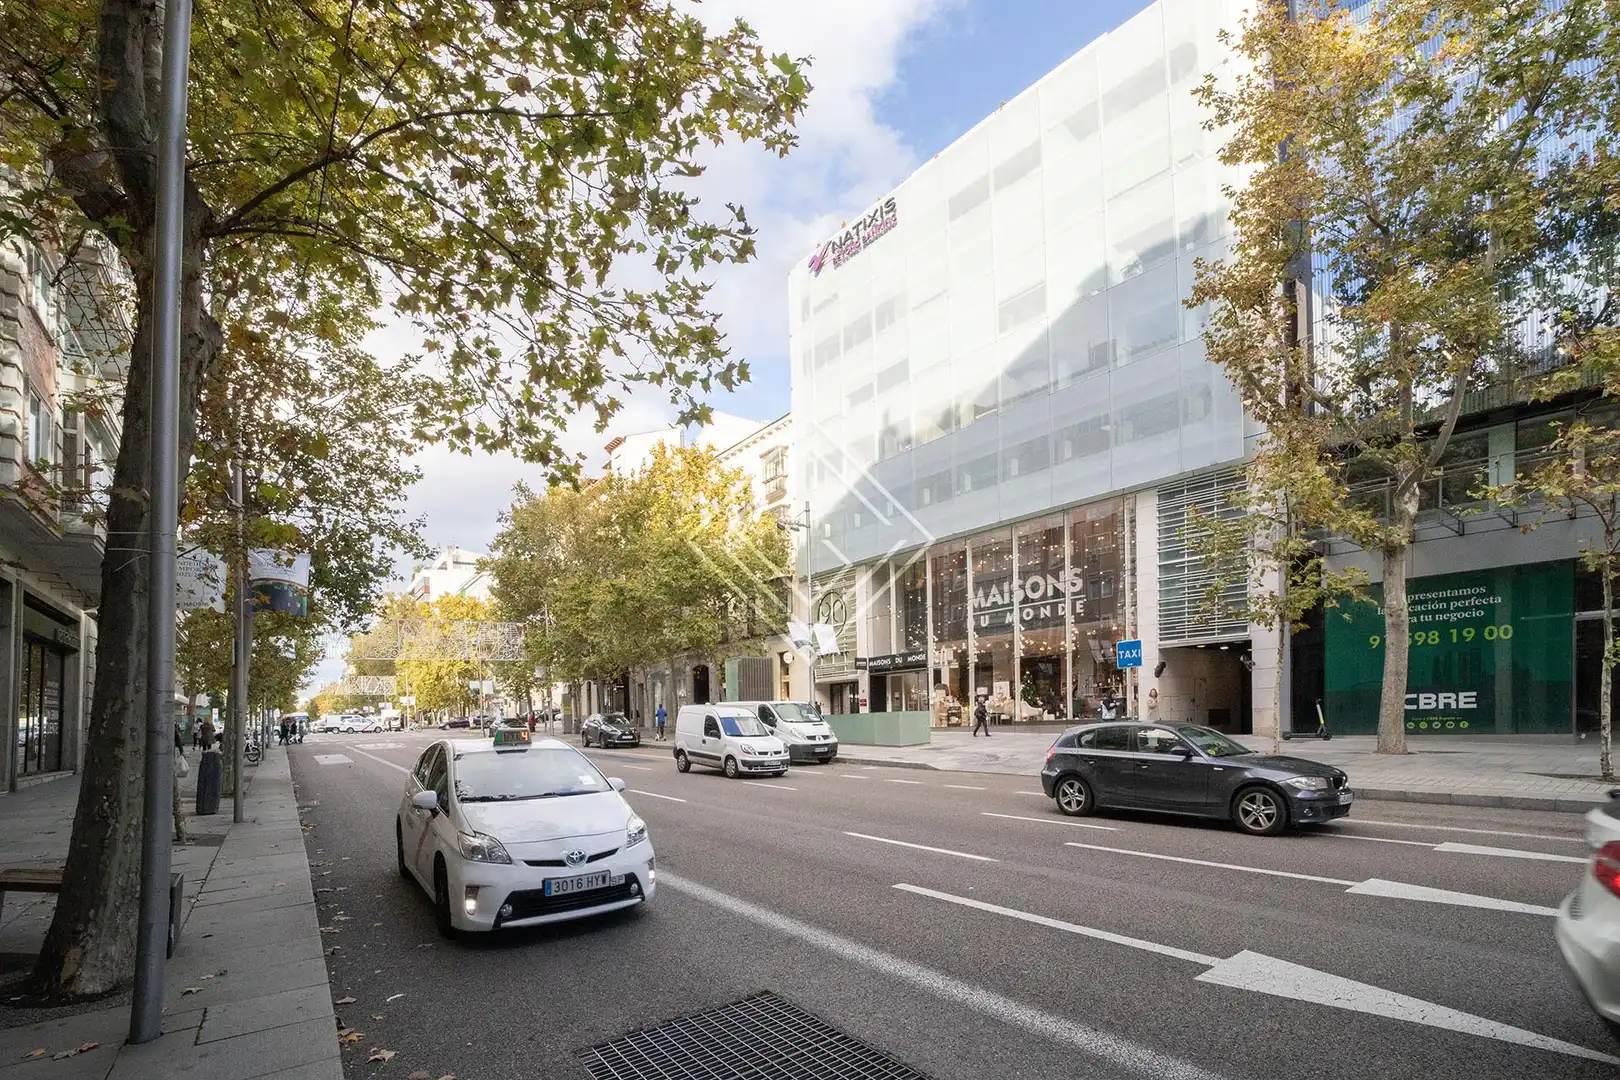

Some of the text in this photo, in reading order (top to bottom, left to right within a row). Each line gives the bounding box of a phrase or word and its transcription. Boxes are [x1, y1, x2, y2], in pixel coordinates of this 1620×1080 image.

[831, 196, 896, 254] NATIXIS
[970, 568, 1083, 608] MAISONS
[1004, 599, 1084, 624] MONDE
[1408, 600, 1447, 612] cación
[1449, 596, 1502, 610] perfecta
[1420, 613, 1432, 622] tu
[1435, 608, 1484, 622] negocio
[1449, 627, 1475, 643] 19
[1483, 624, 1513, 640] 00
[869, 658, 891, 667] MAISONS
[907, 653, 926, 662] MONDE
[1118, 649, 1141, 659] TAXI
[1404, 691, 1477, 710] CBRE
[521, 731, 529, 741] 4
[554, 878, 583, 893] 3016
